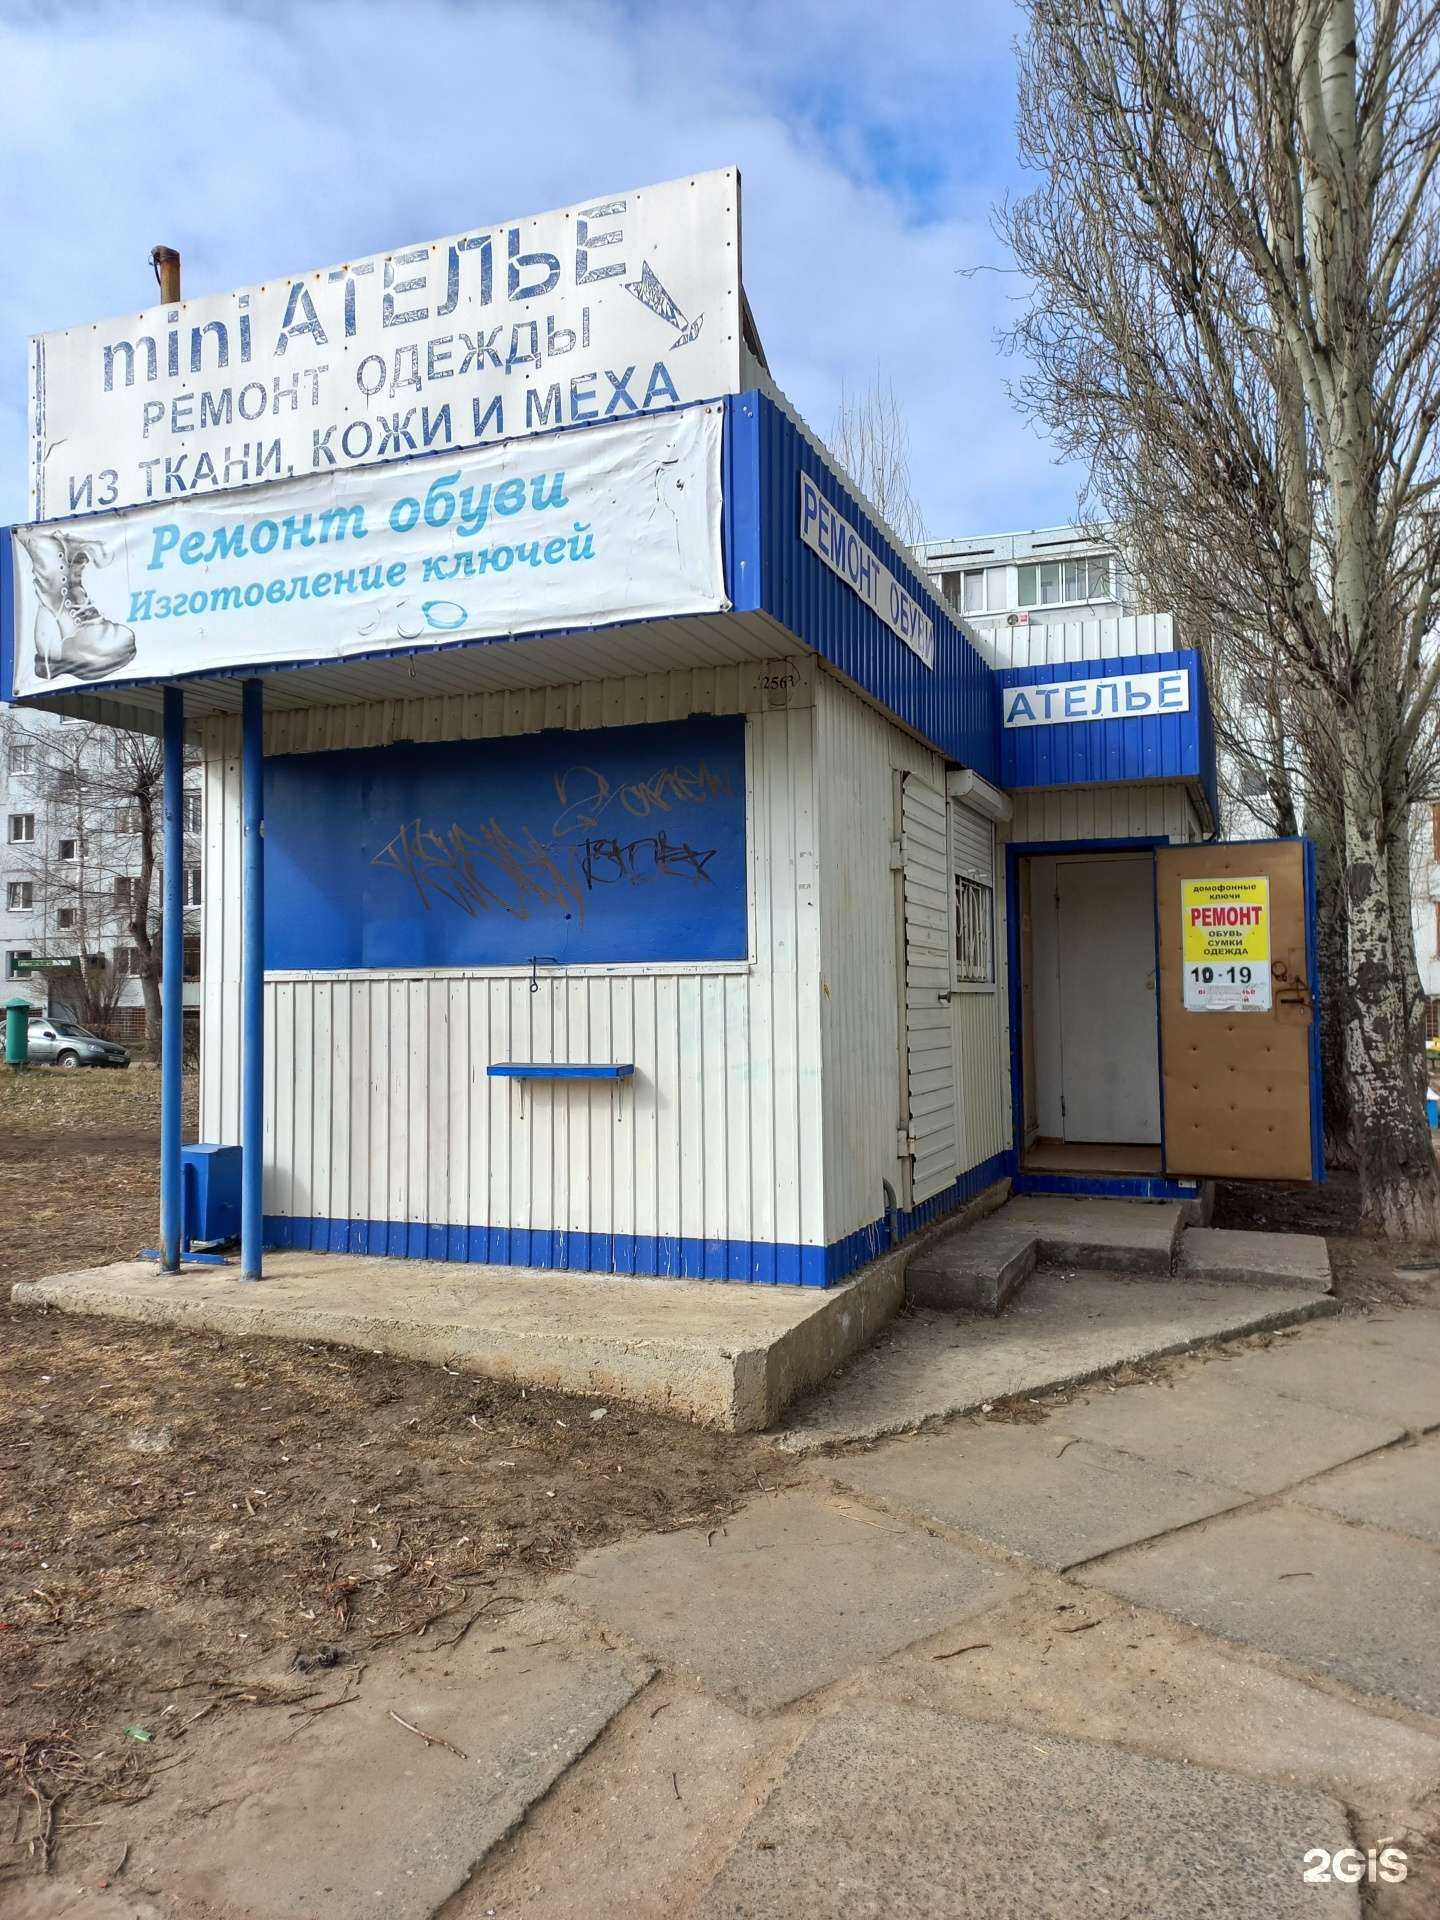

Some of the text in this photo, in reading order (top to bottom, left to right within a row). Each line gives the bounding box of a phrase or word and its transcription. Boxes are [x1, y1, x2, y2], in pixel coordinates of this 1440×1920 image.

[103, 200, 627, 393] mini АТЕЛЬЕ
[142, 306, 591, 439] РЕМОНТ ОДЕЖДЫ
[68, 361, 681, 510] ИЗ ТКАНИ, КОЖИ И МЕХА
[147, 470, 570, 571] Ремонт обуви
[804, 482, 881, 608] РЕМОНТ
[126, 521, 596, 623] Изготовление ключей
[1006, 675, 1184, 723] АТЕЛЬЕ
[1190, 906, 1263, 927] РЕМОНТ
[1193, 883, 1257, 893] домофонные
[1203, 948, 1249, 956] ОДЕЖДА
[1207, 939, 1243, 947] СУМКИ
[1226, 966, 1252, 984] 19
